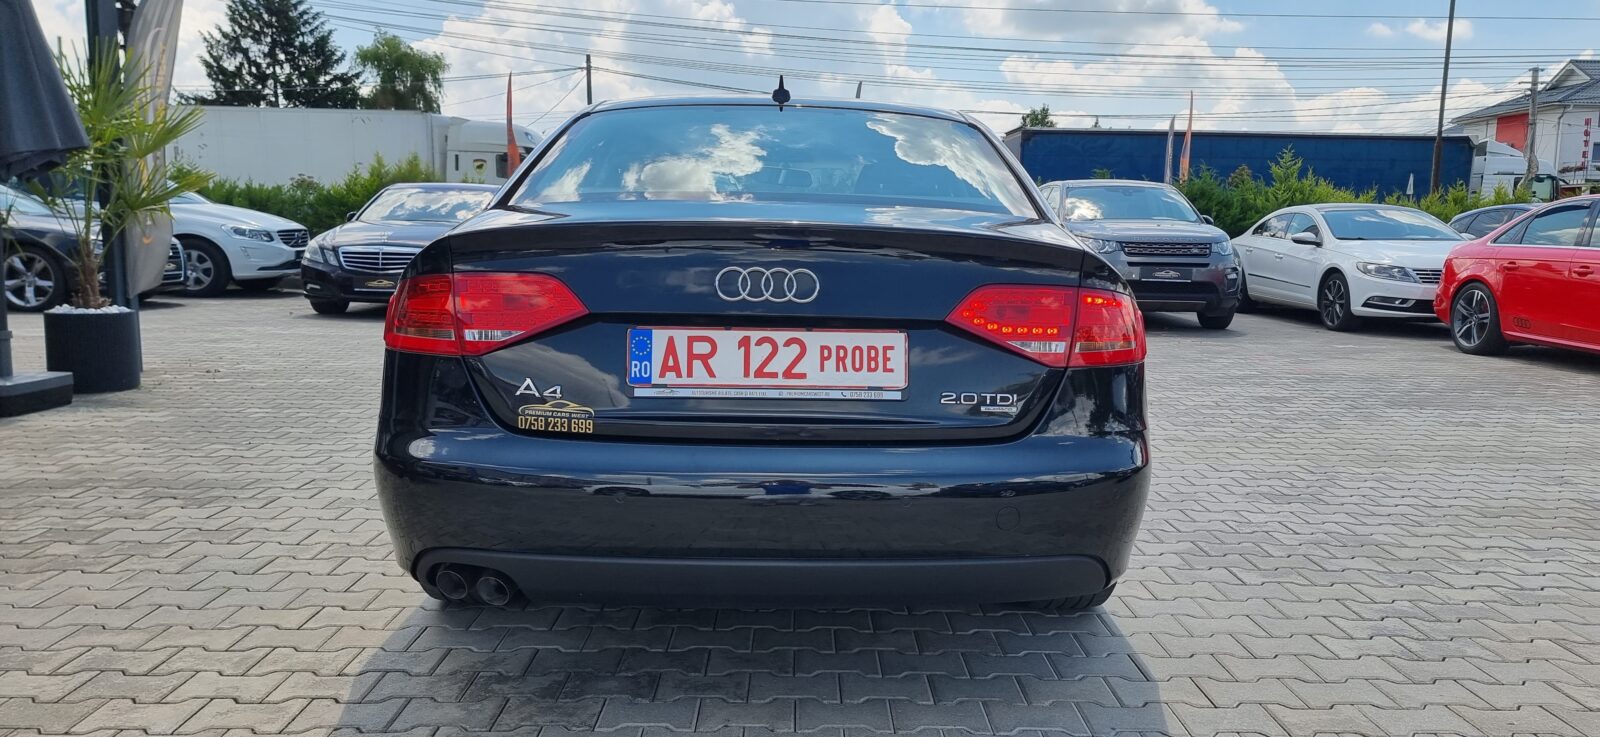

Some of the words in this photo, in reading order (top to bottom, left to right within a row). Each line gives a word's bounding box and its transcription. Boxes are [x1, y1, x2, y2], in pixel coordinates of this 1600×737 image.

[658, 335, 718, 379] AR
[737, 335, 808, 380] 122
[819, 345, 895, 373] PROBE
[631, 360, 651, 378] RO
[515, 377, 562, 399] A4
[940, 392, 978, 405] 2.0
[980, 393, 1018, 406] TDI
[524, 409, 553, 417] PREMIUM
[518, 415, 545, 431] 0758
[547, 417, 568, 432] 233
[571, 419, 593, 434] 699
